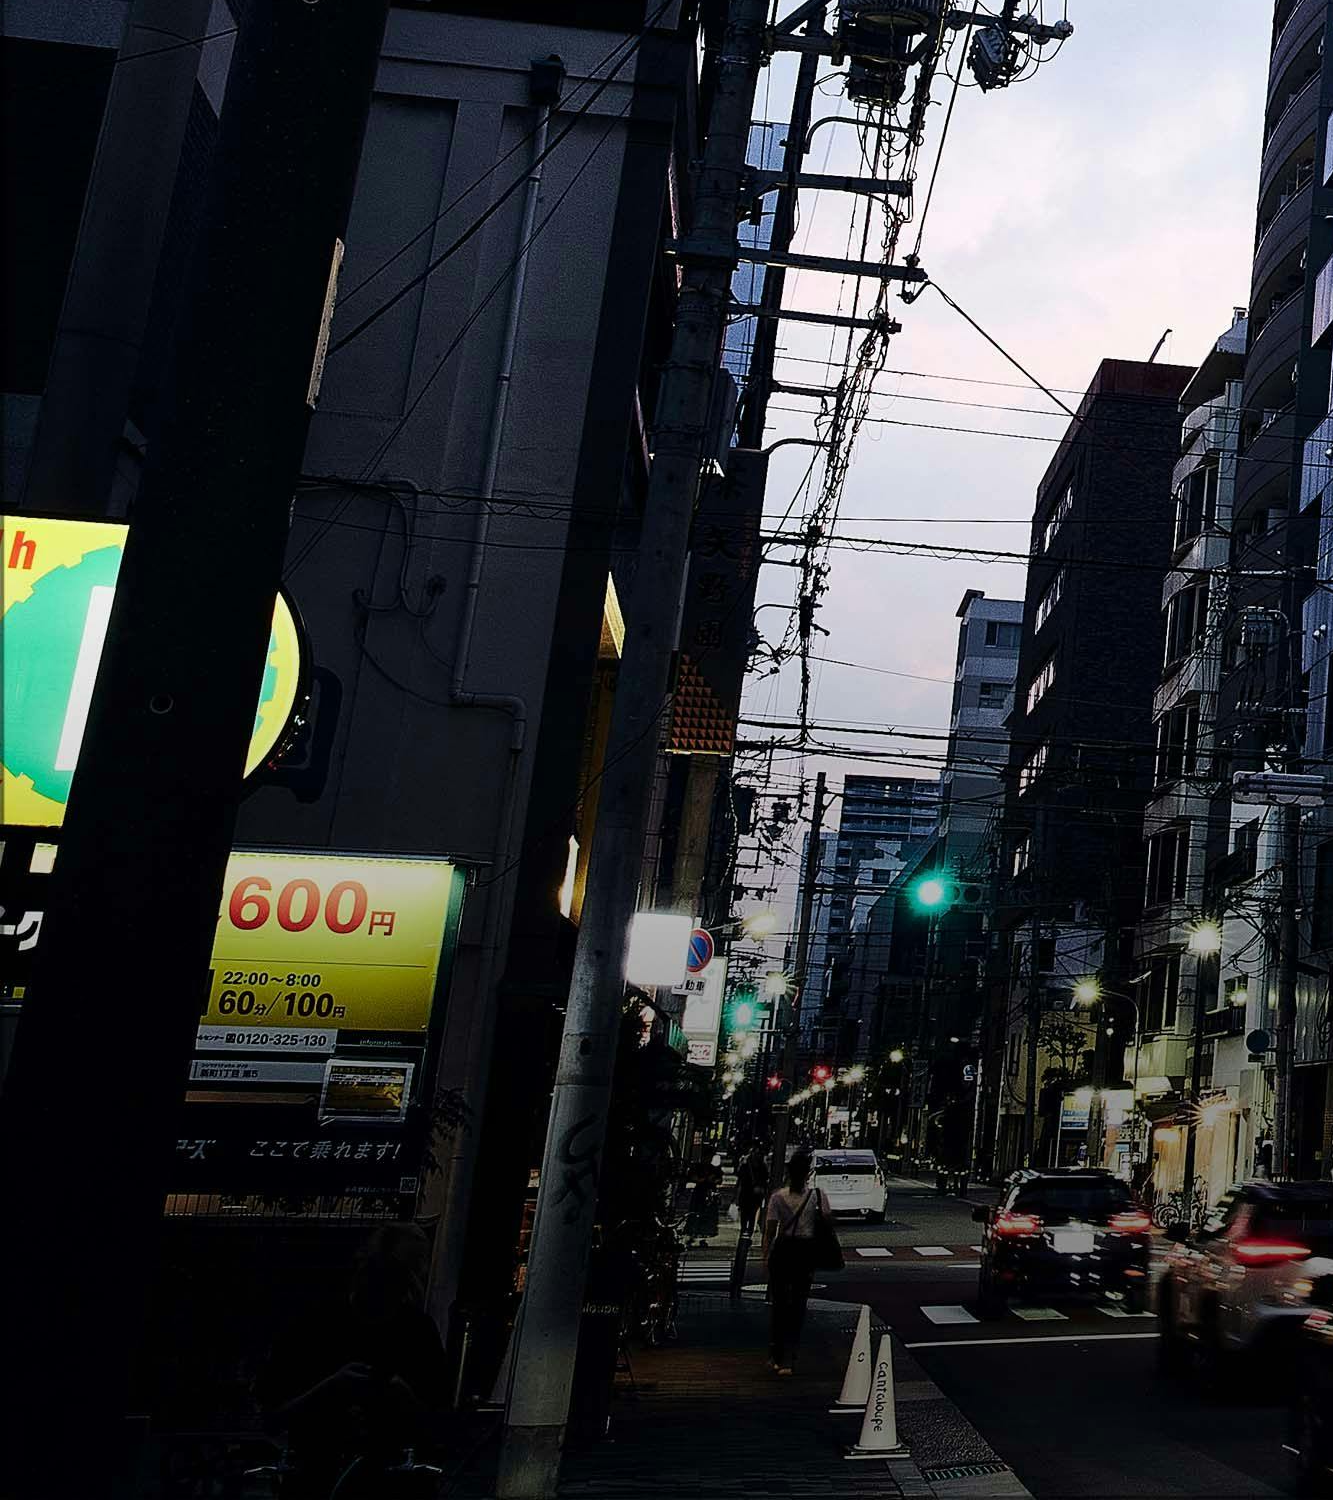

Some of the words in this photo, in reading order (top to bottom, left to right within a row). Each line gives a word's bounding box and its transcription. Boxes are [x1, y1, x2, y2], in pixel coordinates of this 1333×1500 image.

[229, 876, 396, 936] 600円
[236, 1032, 327, 1047] 0120-325-130
[249, 1140, 401, 1160] ここで乗れます!
